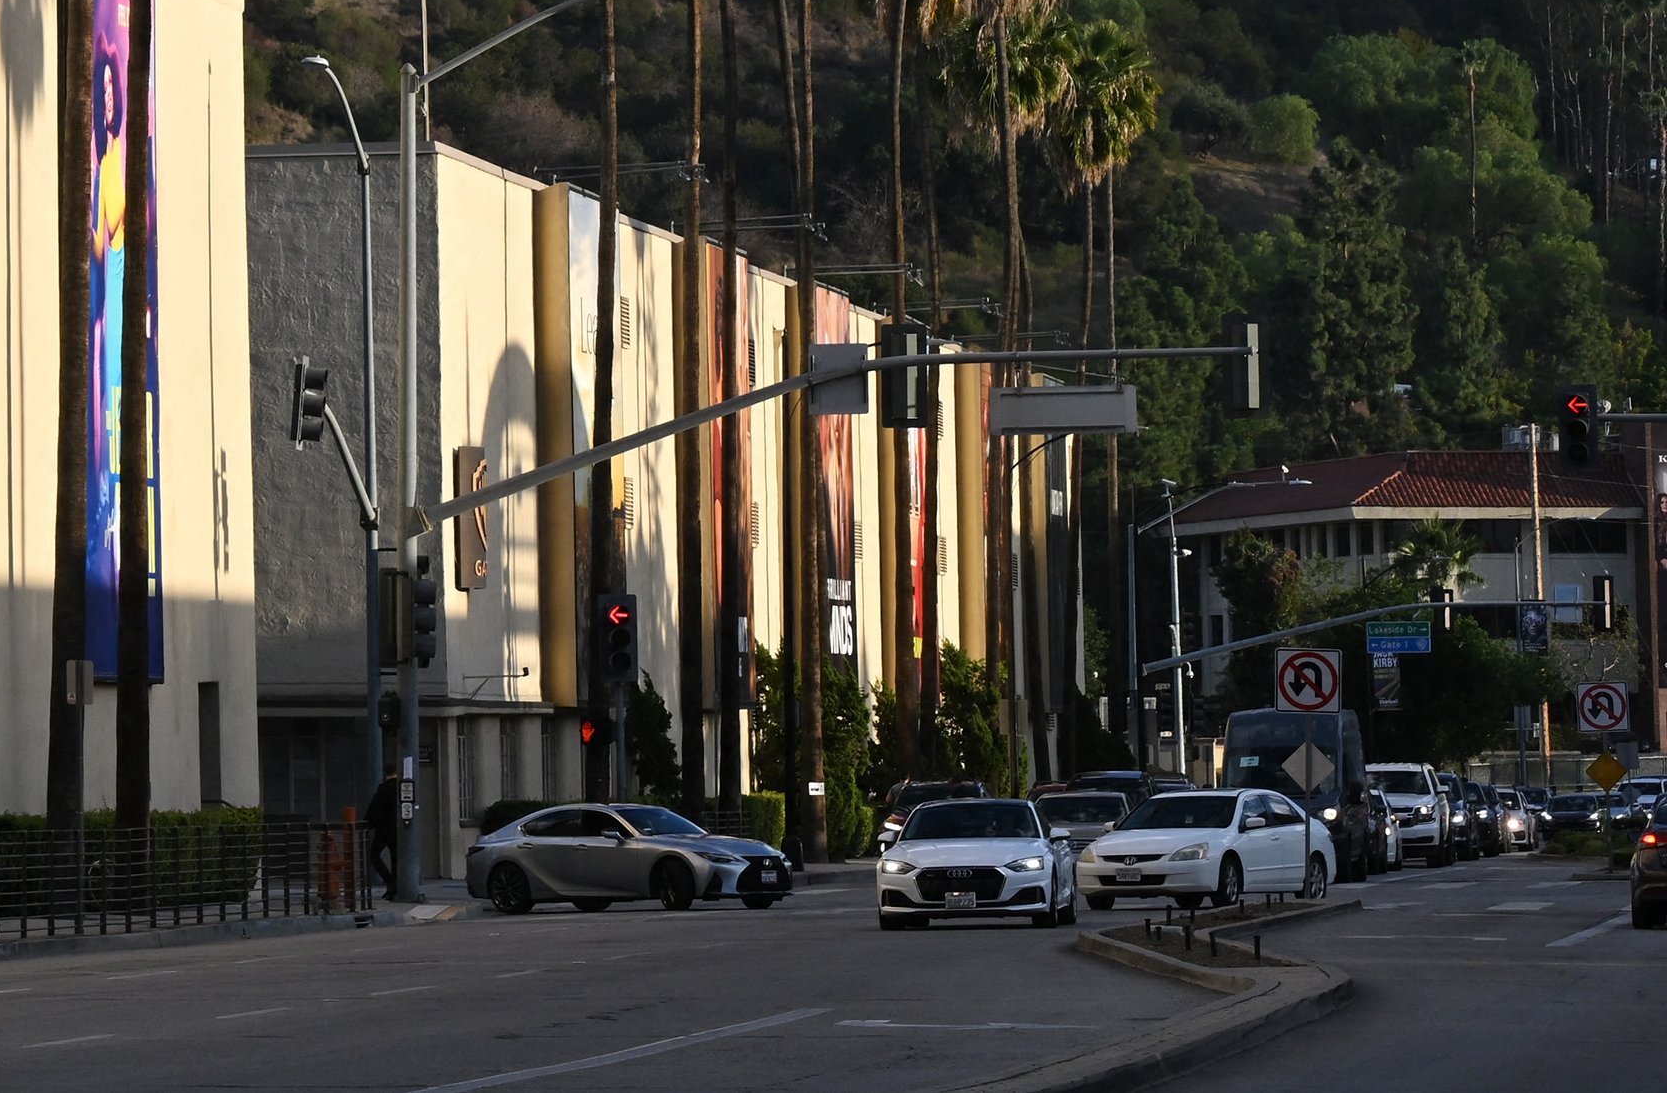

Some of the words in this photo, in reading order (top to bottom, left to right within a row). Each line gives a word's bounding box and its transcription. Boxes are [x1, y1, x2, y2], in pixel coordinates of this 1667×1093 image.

[1368, 625, 1404, 634] Lakeside
[1407, 625, 1417, 634] Dr
[1380, 640, 1401, 649] Gate
[1373, 657, 1398, 668] KIRBY
